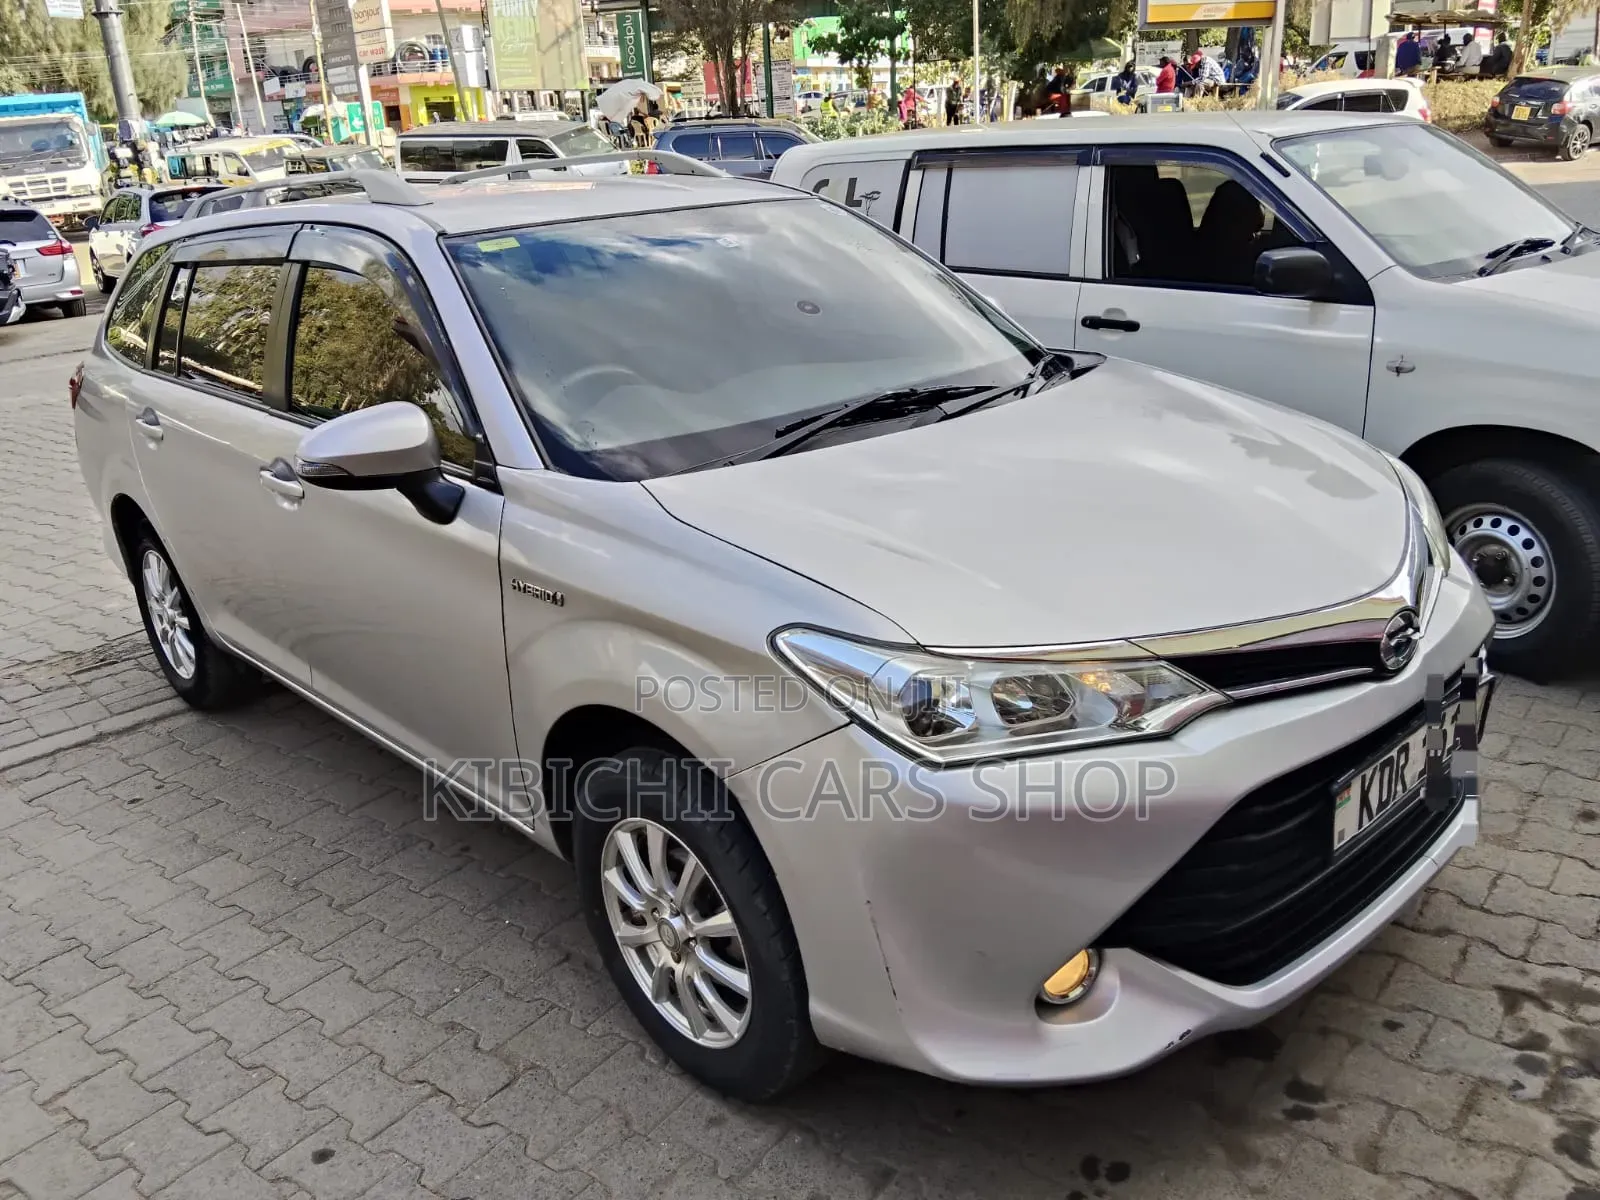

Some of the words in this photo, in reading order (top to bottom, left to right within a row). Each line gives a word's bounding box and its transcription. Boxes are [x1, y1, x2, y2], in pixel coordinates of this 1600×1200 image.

[353, 7, 380, 21] bonjour
[370, 47, 385, 56] wash
[1357, 741, 1410, 831] KDR
